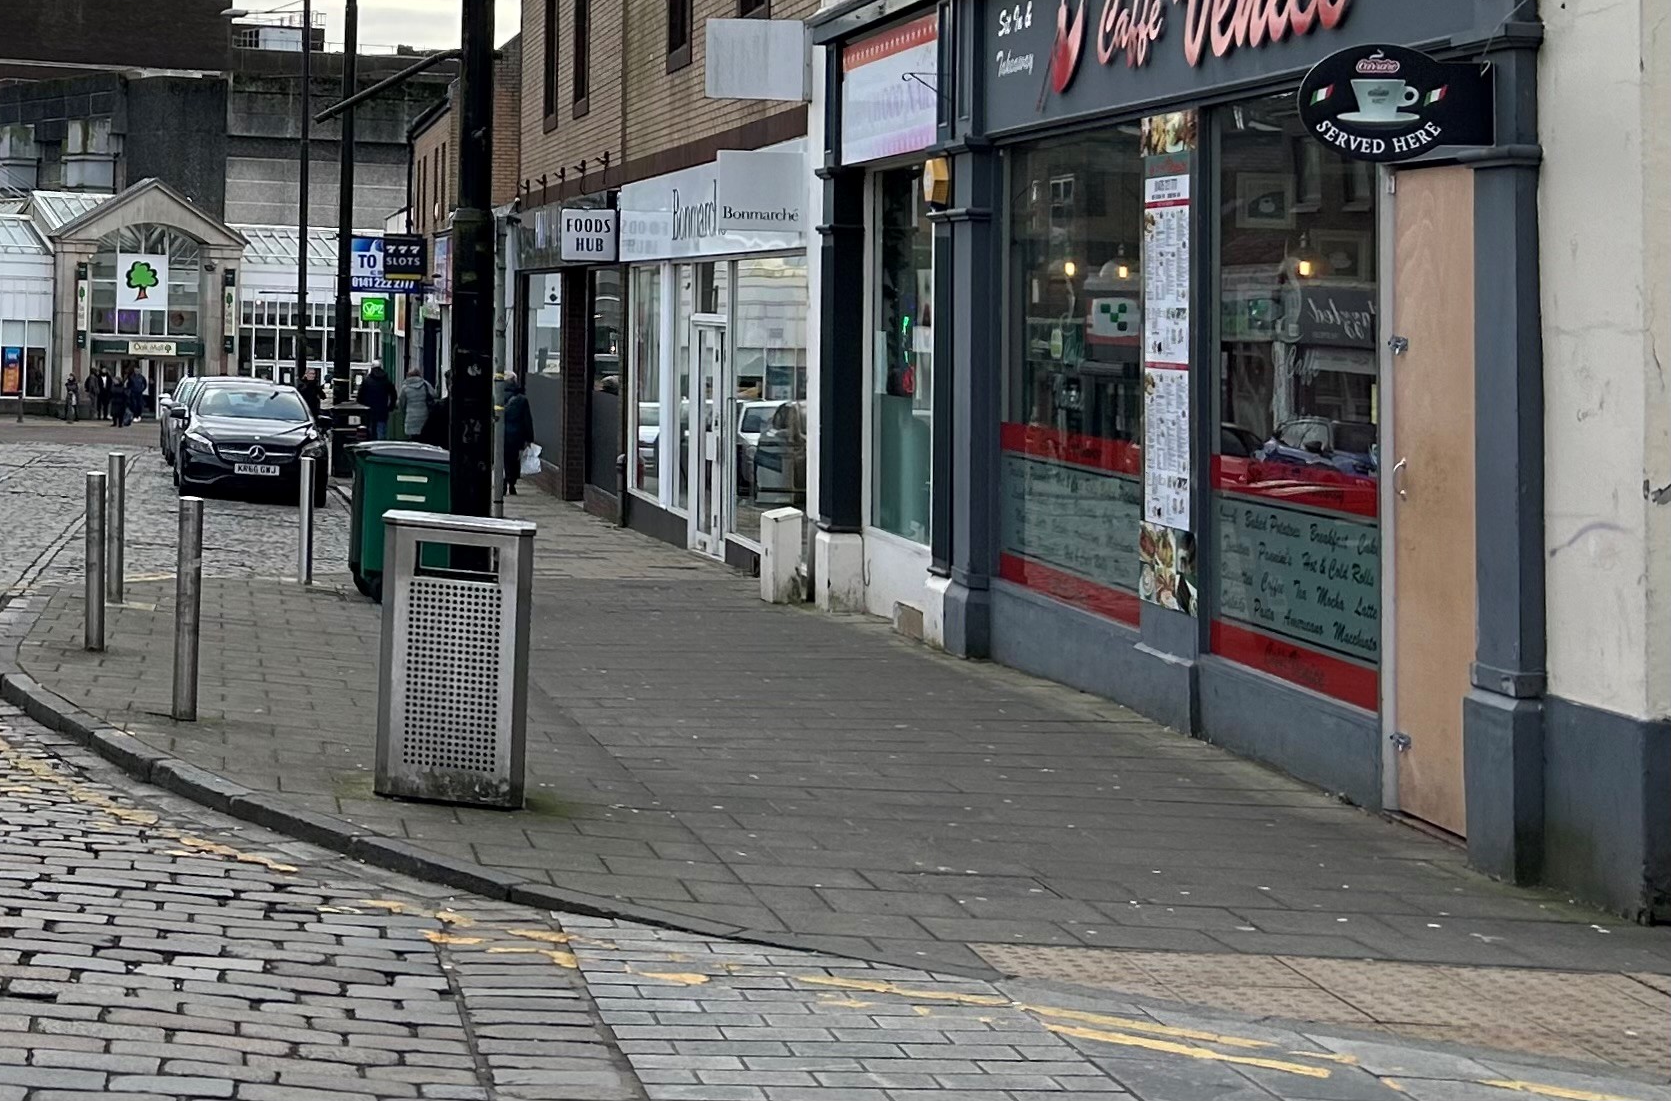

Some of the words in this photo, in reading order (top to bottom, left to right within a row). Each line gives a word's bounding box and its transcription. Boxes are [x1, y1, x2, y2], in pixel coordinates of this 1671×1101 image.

[1315, 120, 1386, 154] SERVED
[1392, 121, 1442, 153] HERE
[722, 205, 800, 221] Bonmarché
[566, 218, 611, 233] FOODS
[575, 237, 604, 252] HUB
[358, 254, 377, 268] TO
[385, 257, 421, 266] SLOTS
[352, 276, 373, 288] 0141
